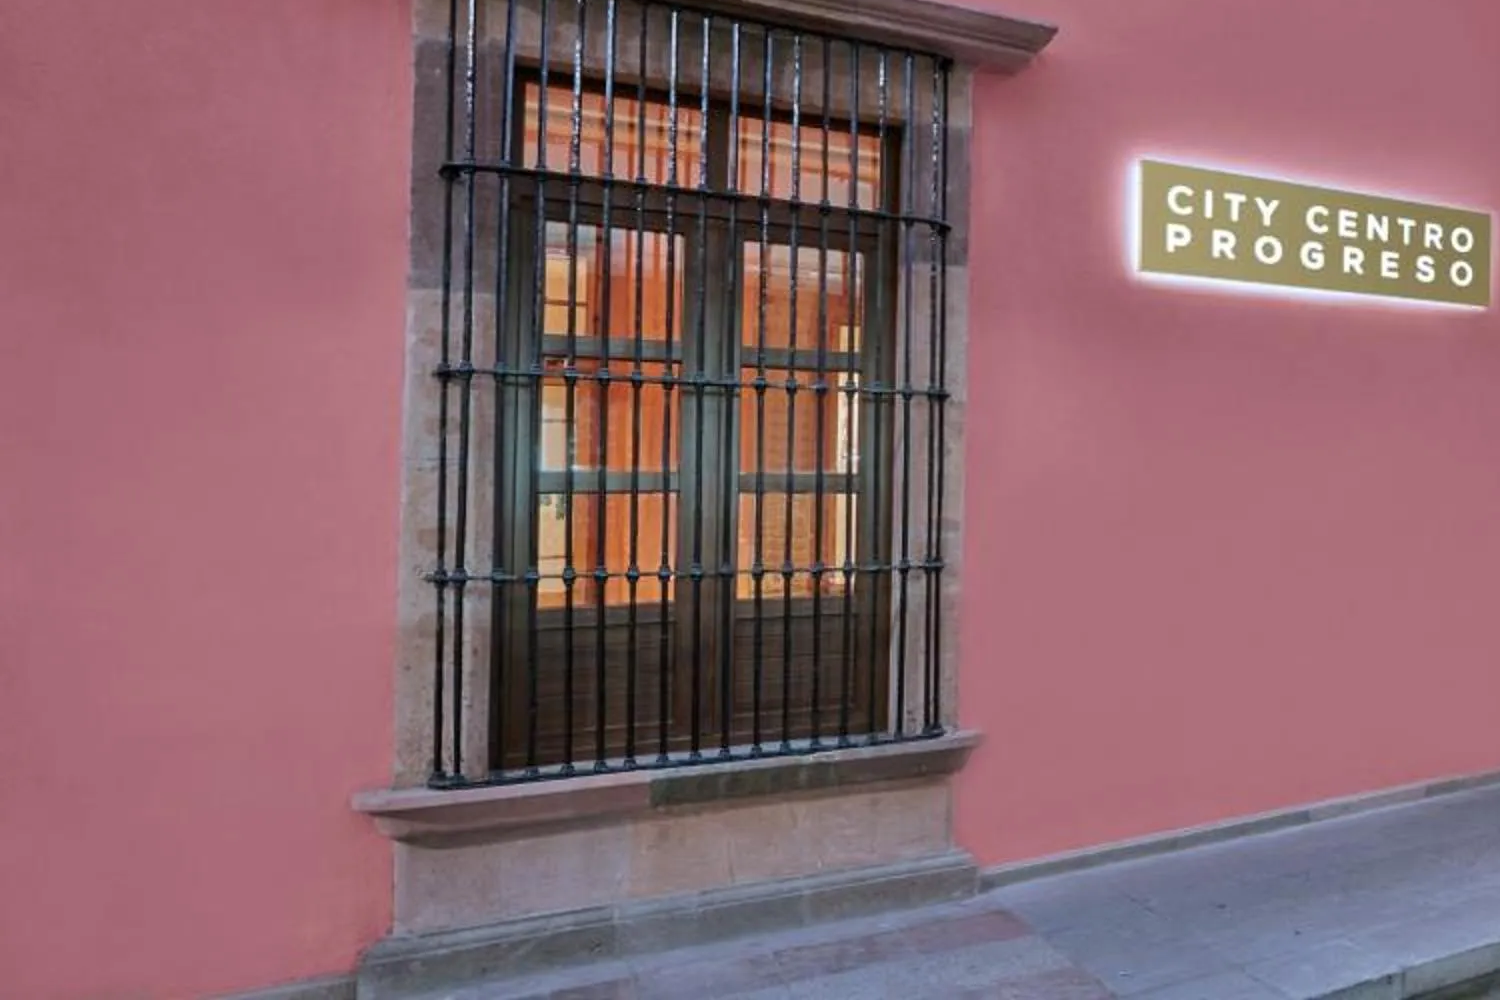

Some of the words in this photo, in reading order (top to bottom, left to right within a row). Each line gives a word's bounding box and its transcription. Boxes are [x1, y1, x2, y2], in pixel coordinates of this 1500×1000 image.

[1167, 184, 1280, 227] CITY
[1305, 205, 1474, 253] CENTRO
[1165, 223, 1473, 287] PROGRESO
